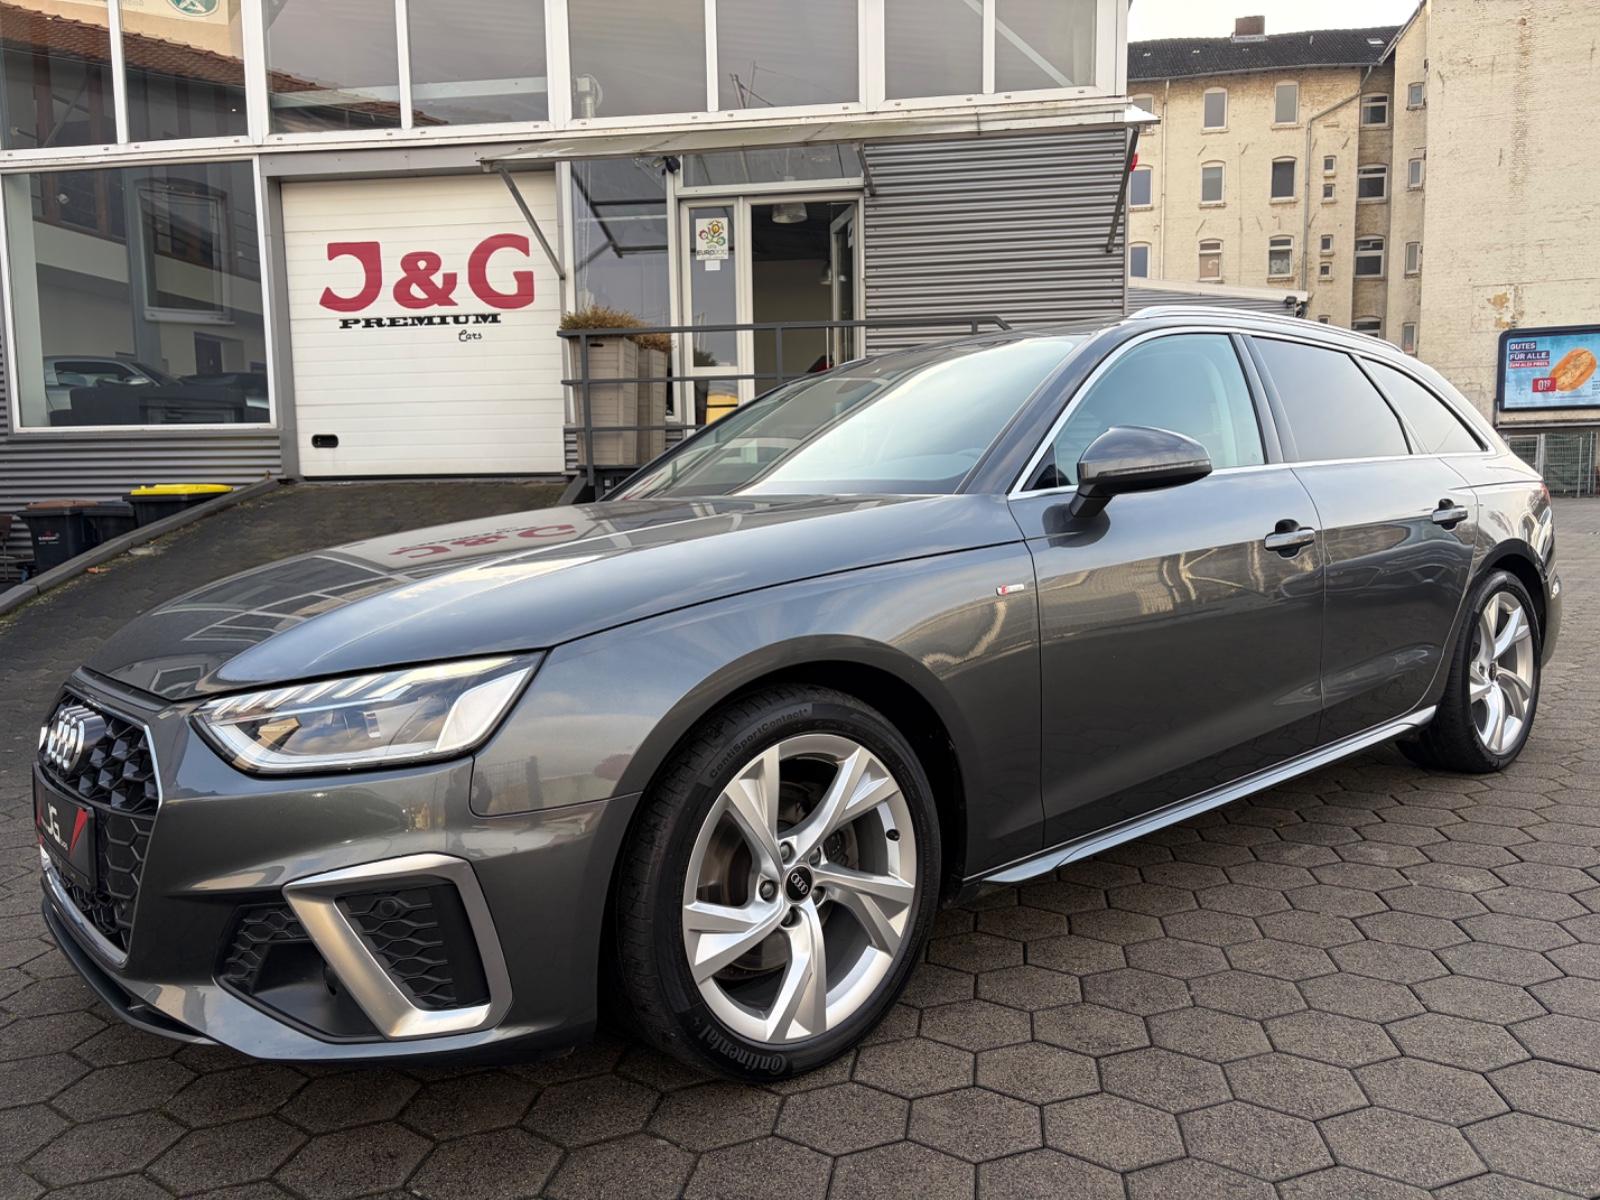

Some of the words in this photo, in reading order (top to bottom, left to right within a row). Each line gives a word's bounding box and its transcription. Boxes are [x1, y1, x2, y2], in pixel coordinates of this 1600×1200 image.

[319, 233, 535, 312] J&G
[339, 313, 501, 328] PREMIUM
[458, 329, 482, 341] Cars
[698, 1024, 788, 1076] Continental
